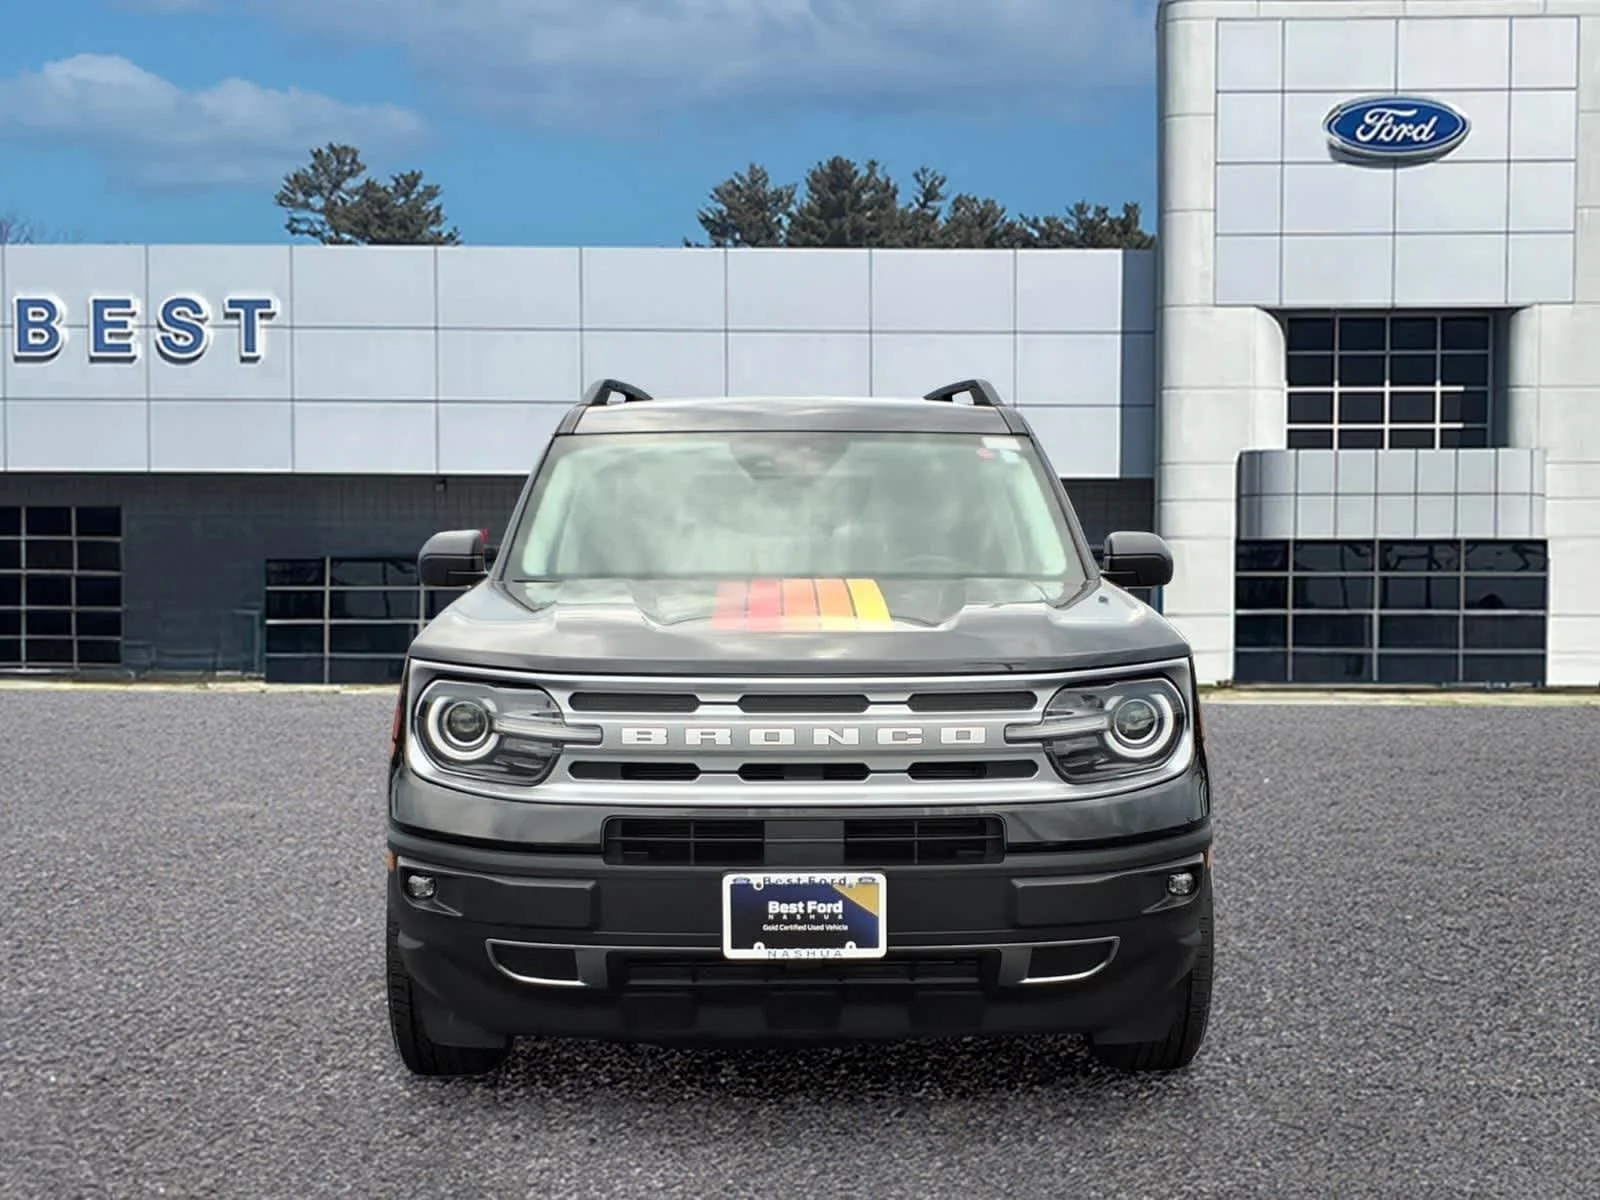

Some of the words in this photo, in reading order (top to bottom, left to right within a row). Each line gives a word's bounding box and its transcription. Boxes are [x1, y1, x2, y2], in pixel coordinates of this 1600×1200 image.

[1355, 107, 1438, 142] Ford
[13, 295, 276, 362] BEST
[621, 727, 988, 745] BRONCO
[763, 876, 802, 886] Best
[809, 876, 847, 886] Ford
[768, 900, 805, 914] Best
[807, 900, 843, 914] Ford
[768, 950, 842, 958] NASHUA
